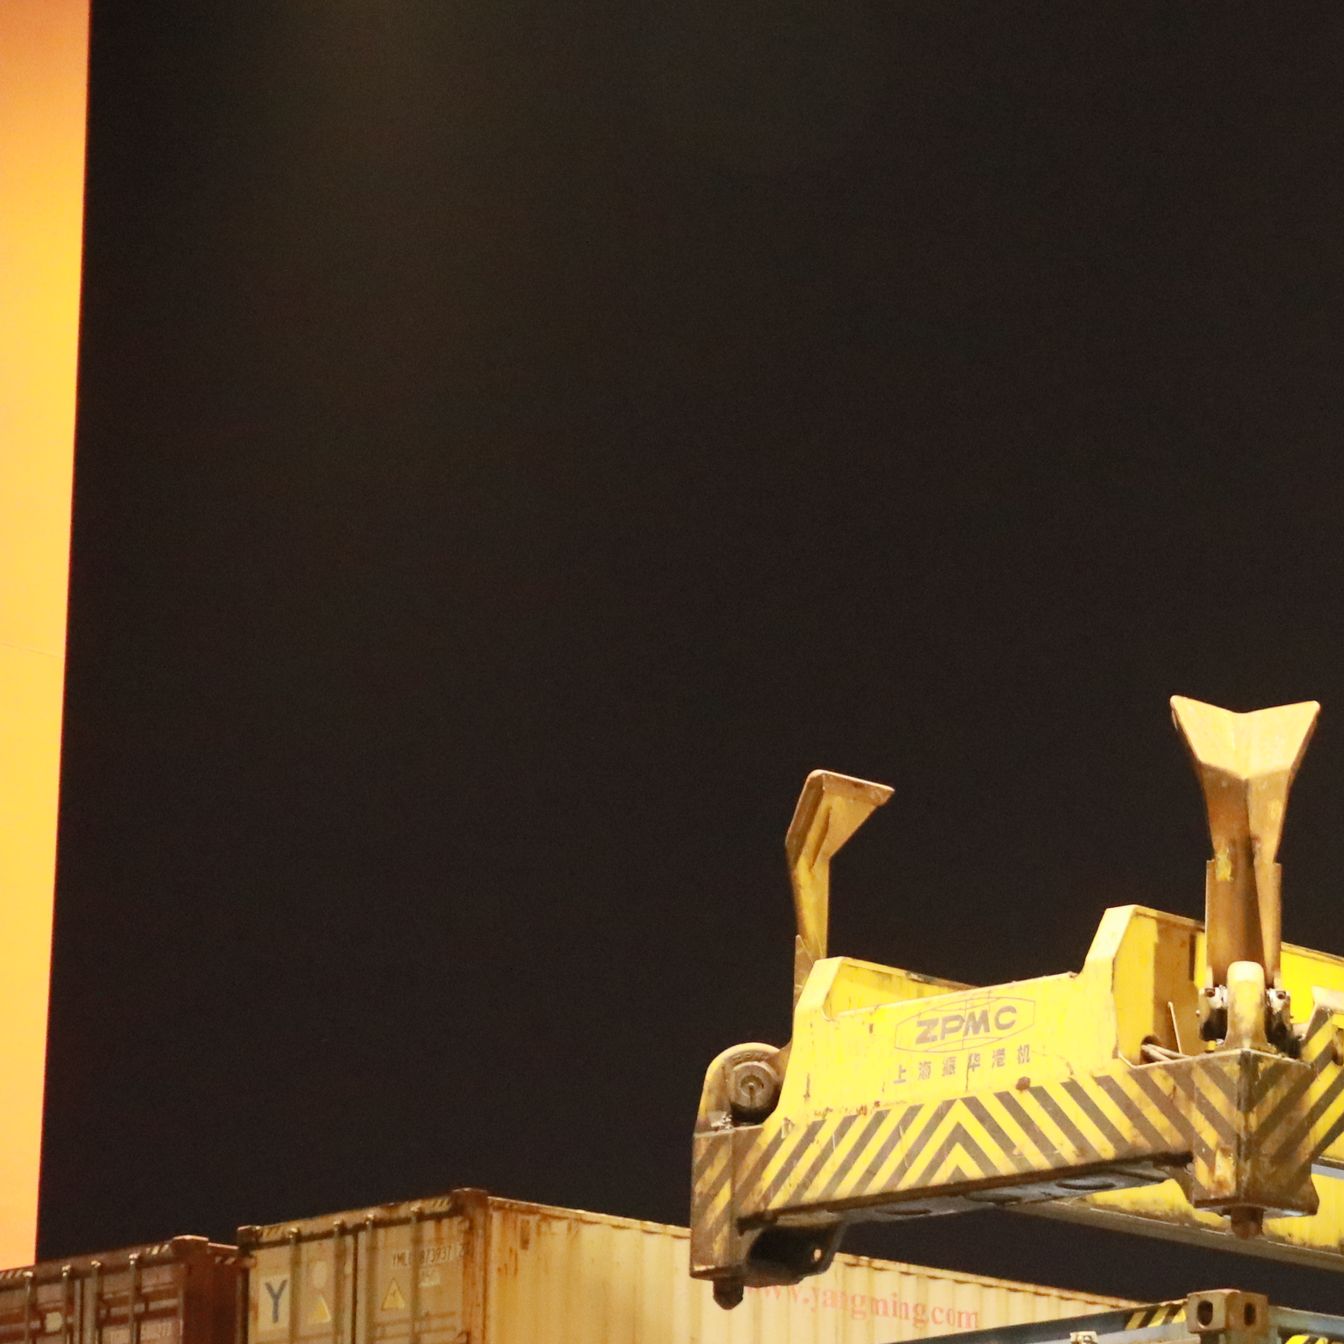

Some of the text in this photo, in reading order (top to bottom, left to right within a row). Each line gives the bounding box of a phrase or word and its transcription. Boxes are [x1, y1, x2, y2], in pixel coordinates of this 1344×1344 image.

[915, 1005, 1018, 1045] ZPMC
[893, 1044, 1031, 1085] 上海振华港机
